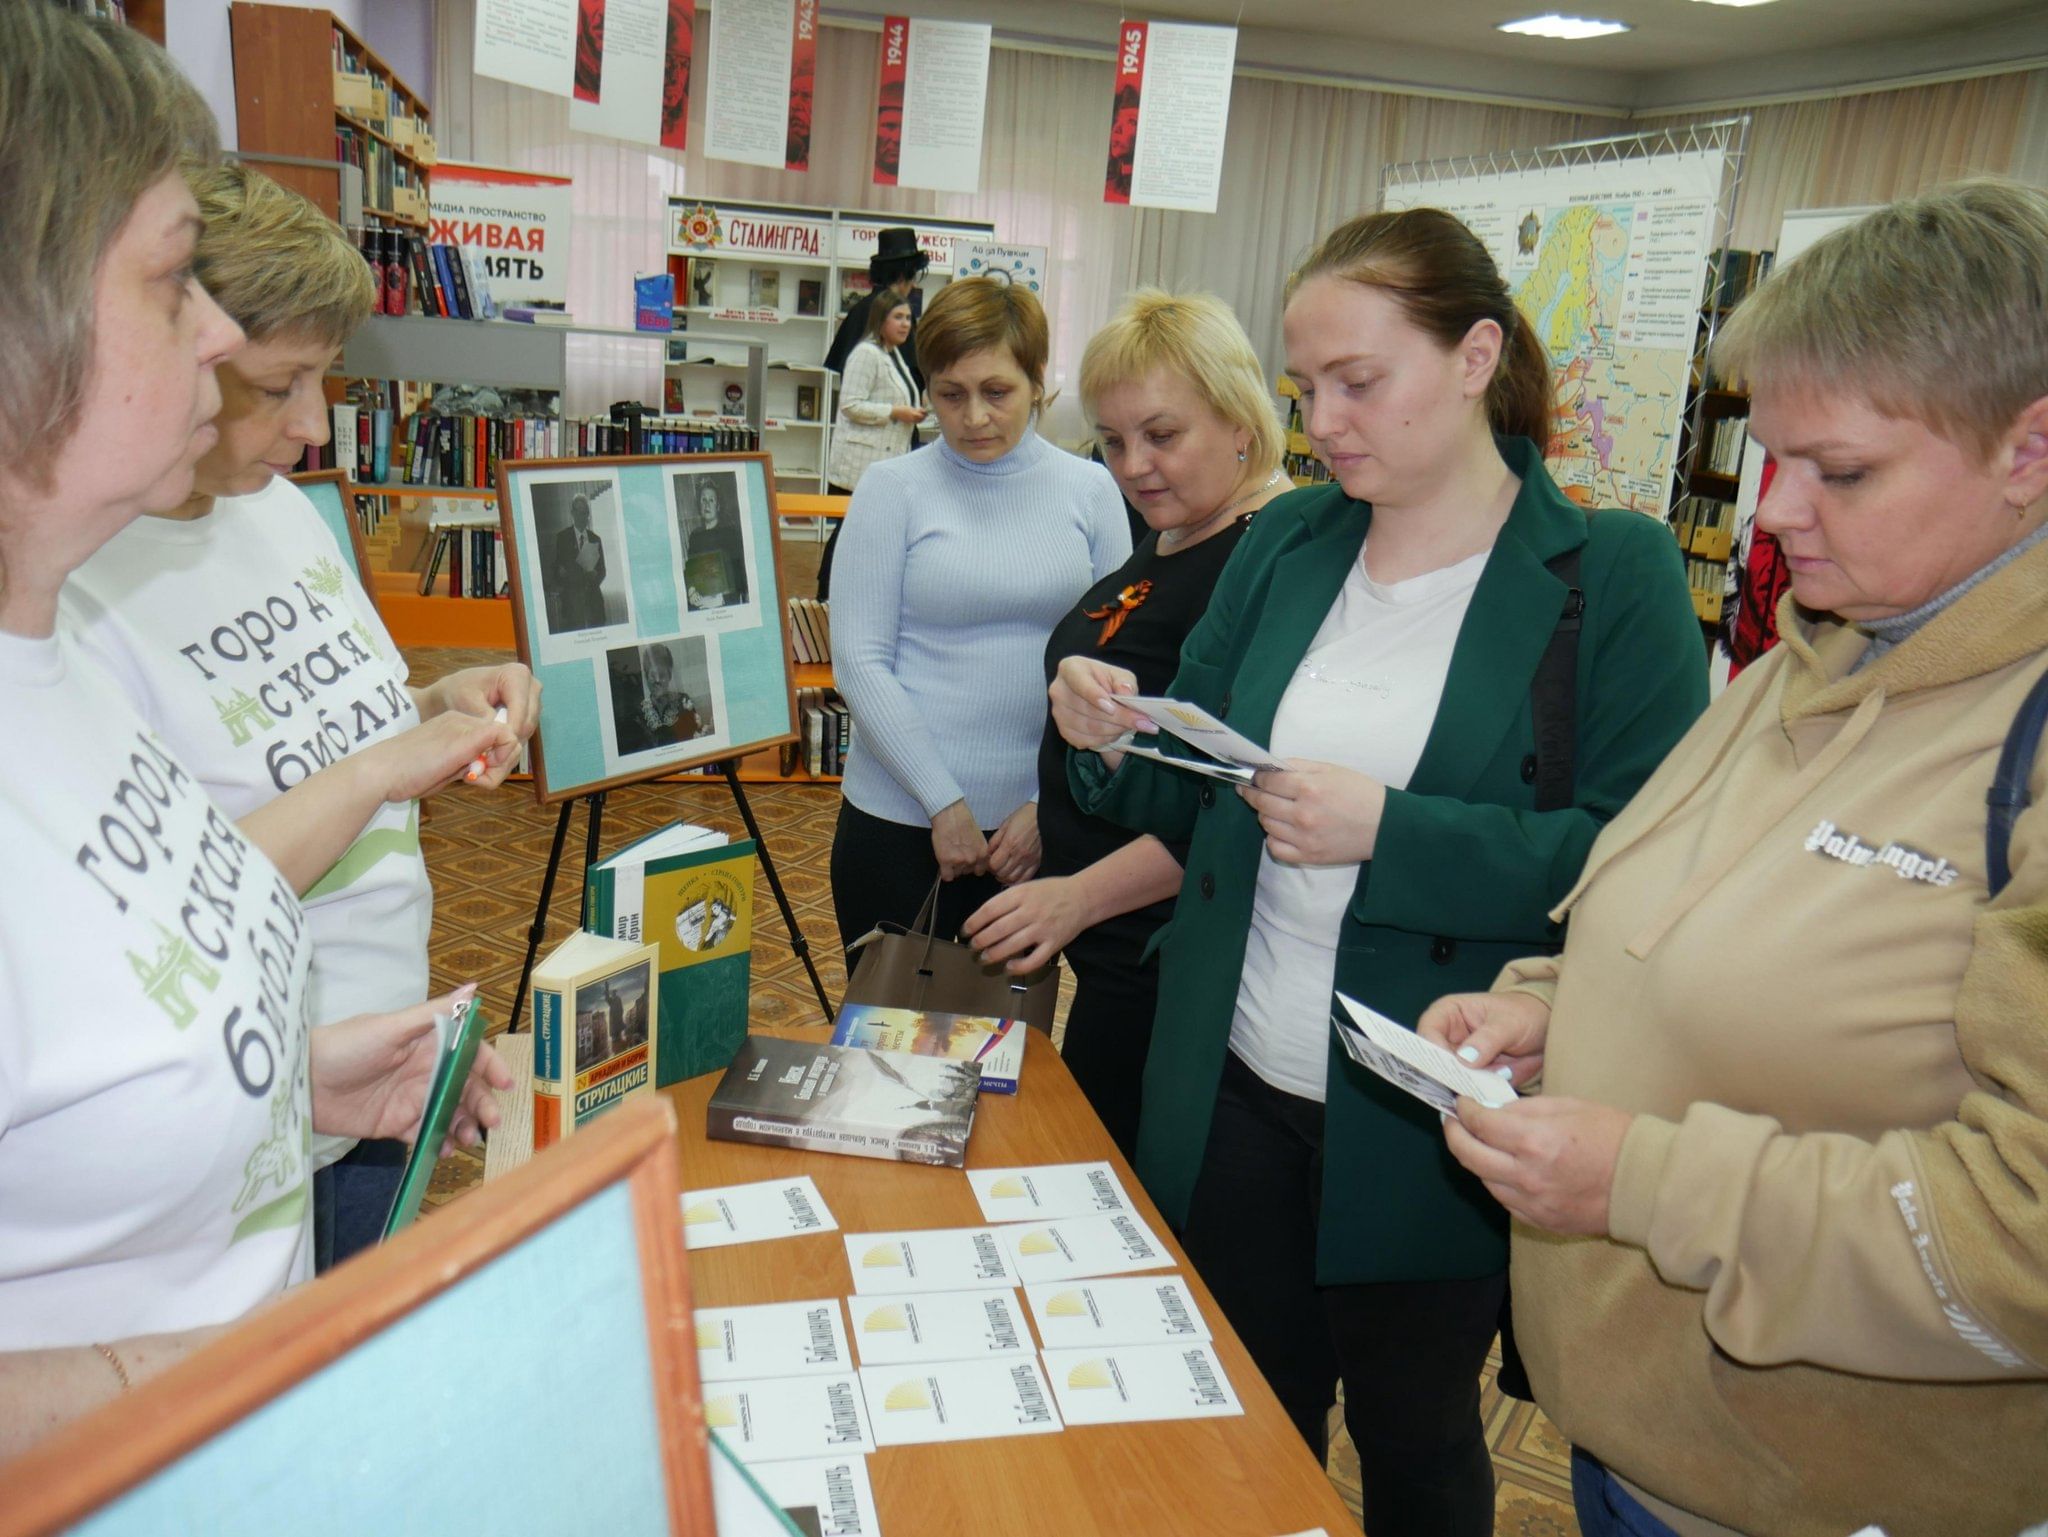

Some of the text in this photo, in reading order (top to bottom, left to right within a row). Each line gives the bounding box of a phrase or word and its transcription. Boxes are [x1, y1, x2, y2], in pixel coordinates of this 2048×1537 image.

[887, 24, 904, 66] 1944
[1122, 30, 1142, 75] 1945
[429, 218, 545, 253] ЖИВАЯ
[469, 206, 546, 223] ПРОСТРАНСТВО
[576, 1065, 647, 1113] СТРУГАЦКИЕ
